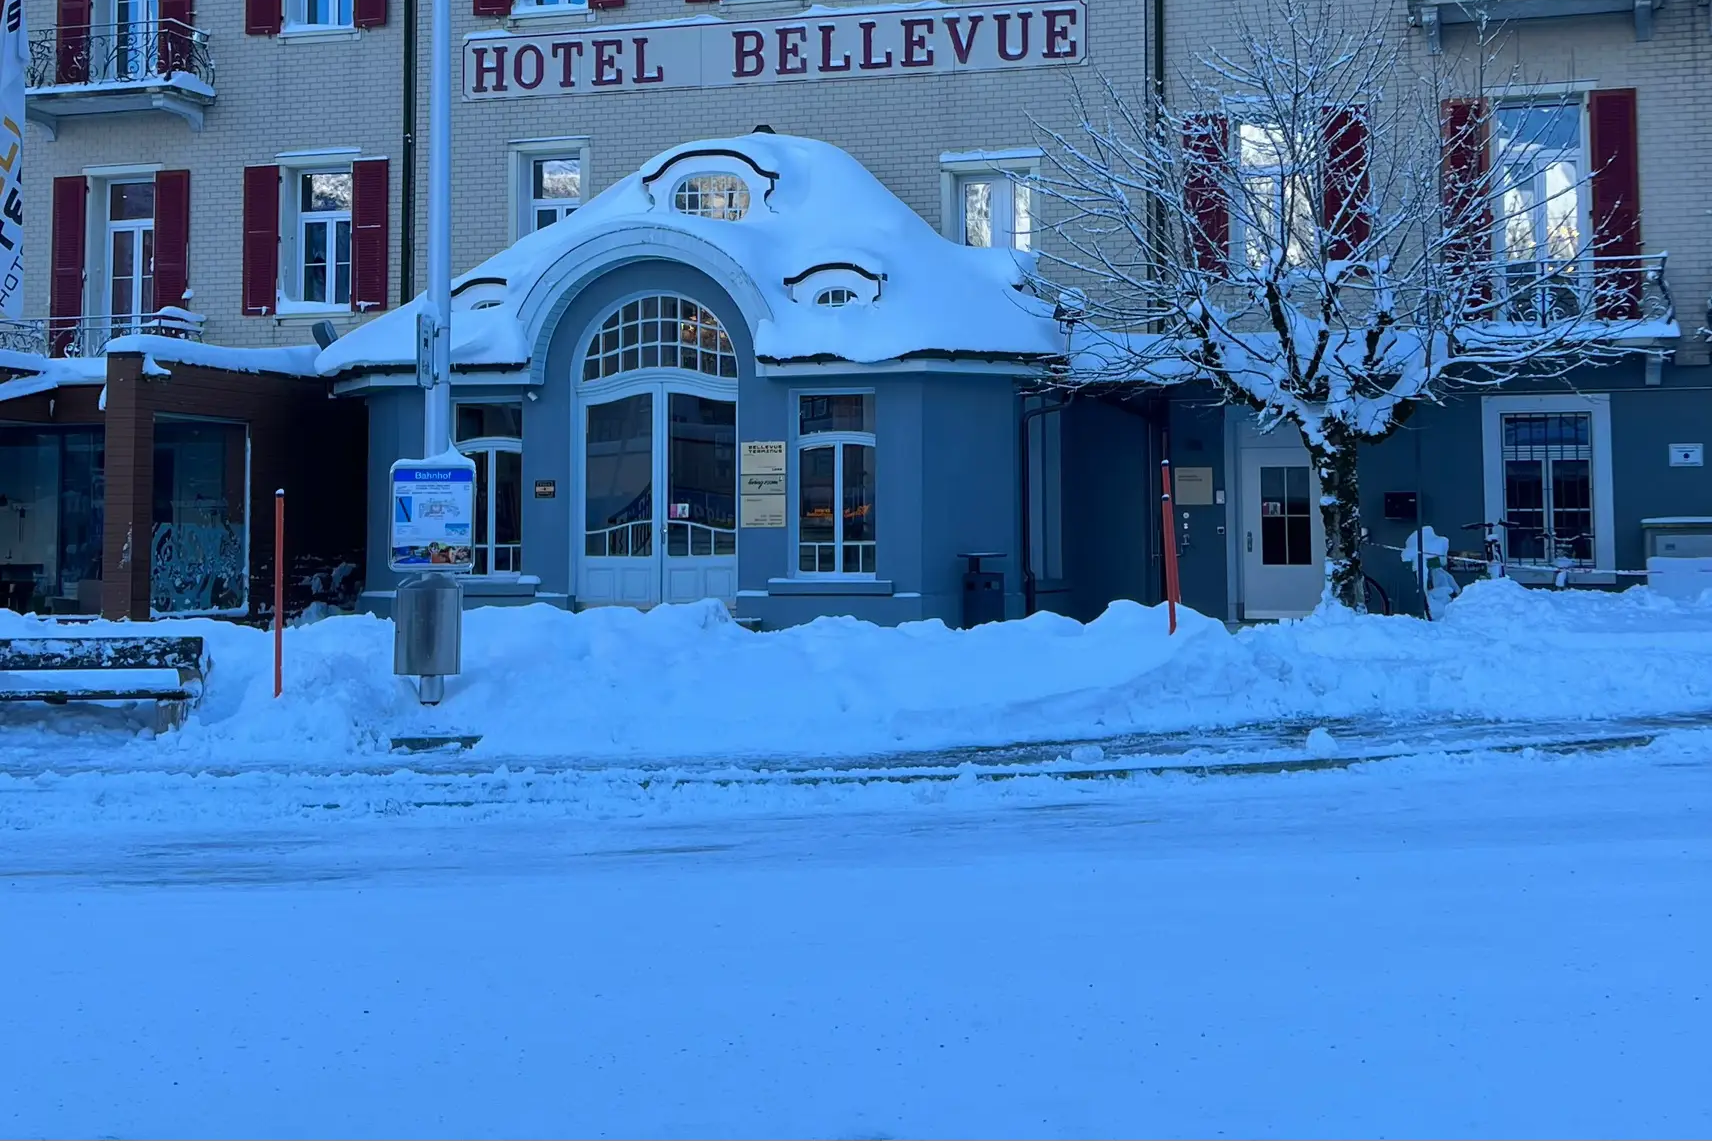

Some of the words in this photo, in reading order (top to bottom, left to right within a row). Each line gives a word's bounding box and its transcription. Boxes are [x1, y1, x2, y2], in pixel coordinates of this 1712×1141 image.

[471, 36, 665, 93] HOTEL
[732, 8, 1077, 78] BELLEVUE
[0, 245, 24, 308] HOT
[415, 471, 452, 480] Bahnhof
